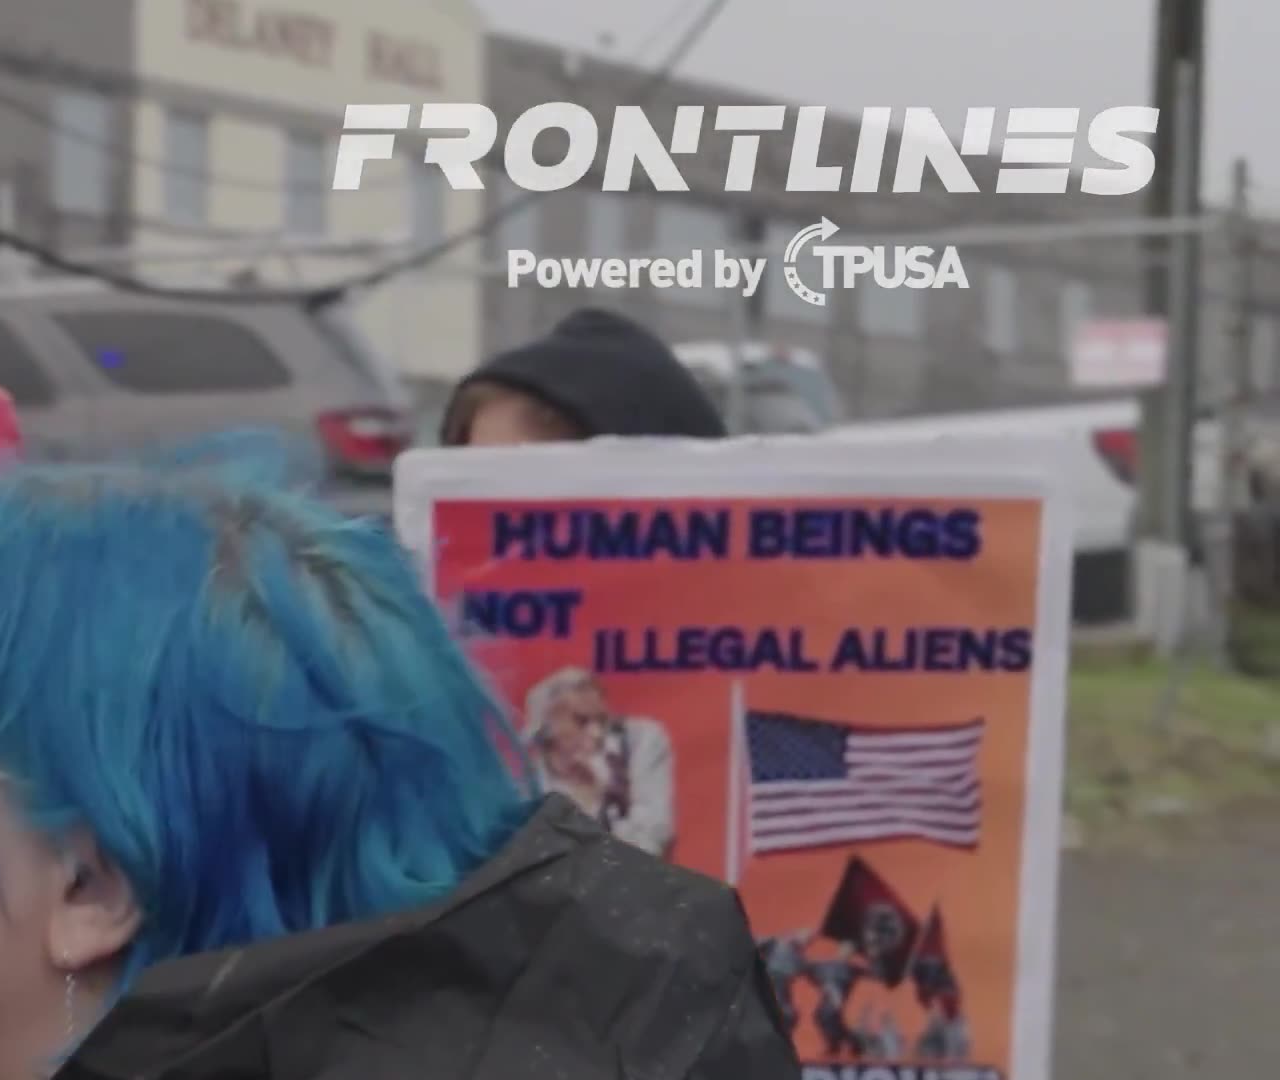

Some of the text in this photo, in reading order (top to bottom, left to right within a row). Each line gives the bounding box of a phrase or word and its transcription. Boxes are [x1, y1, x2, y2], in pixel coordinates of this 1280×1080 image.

[366, 29, 446, 94] HALL
[493, 508, 982, 561] HUMAN BEINGS
[459, 590, 583, 639] NOT
[594, 629, 1033, 673] ILLEGAL ALIENS
